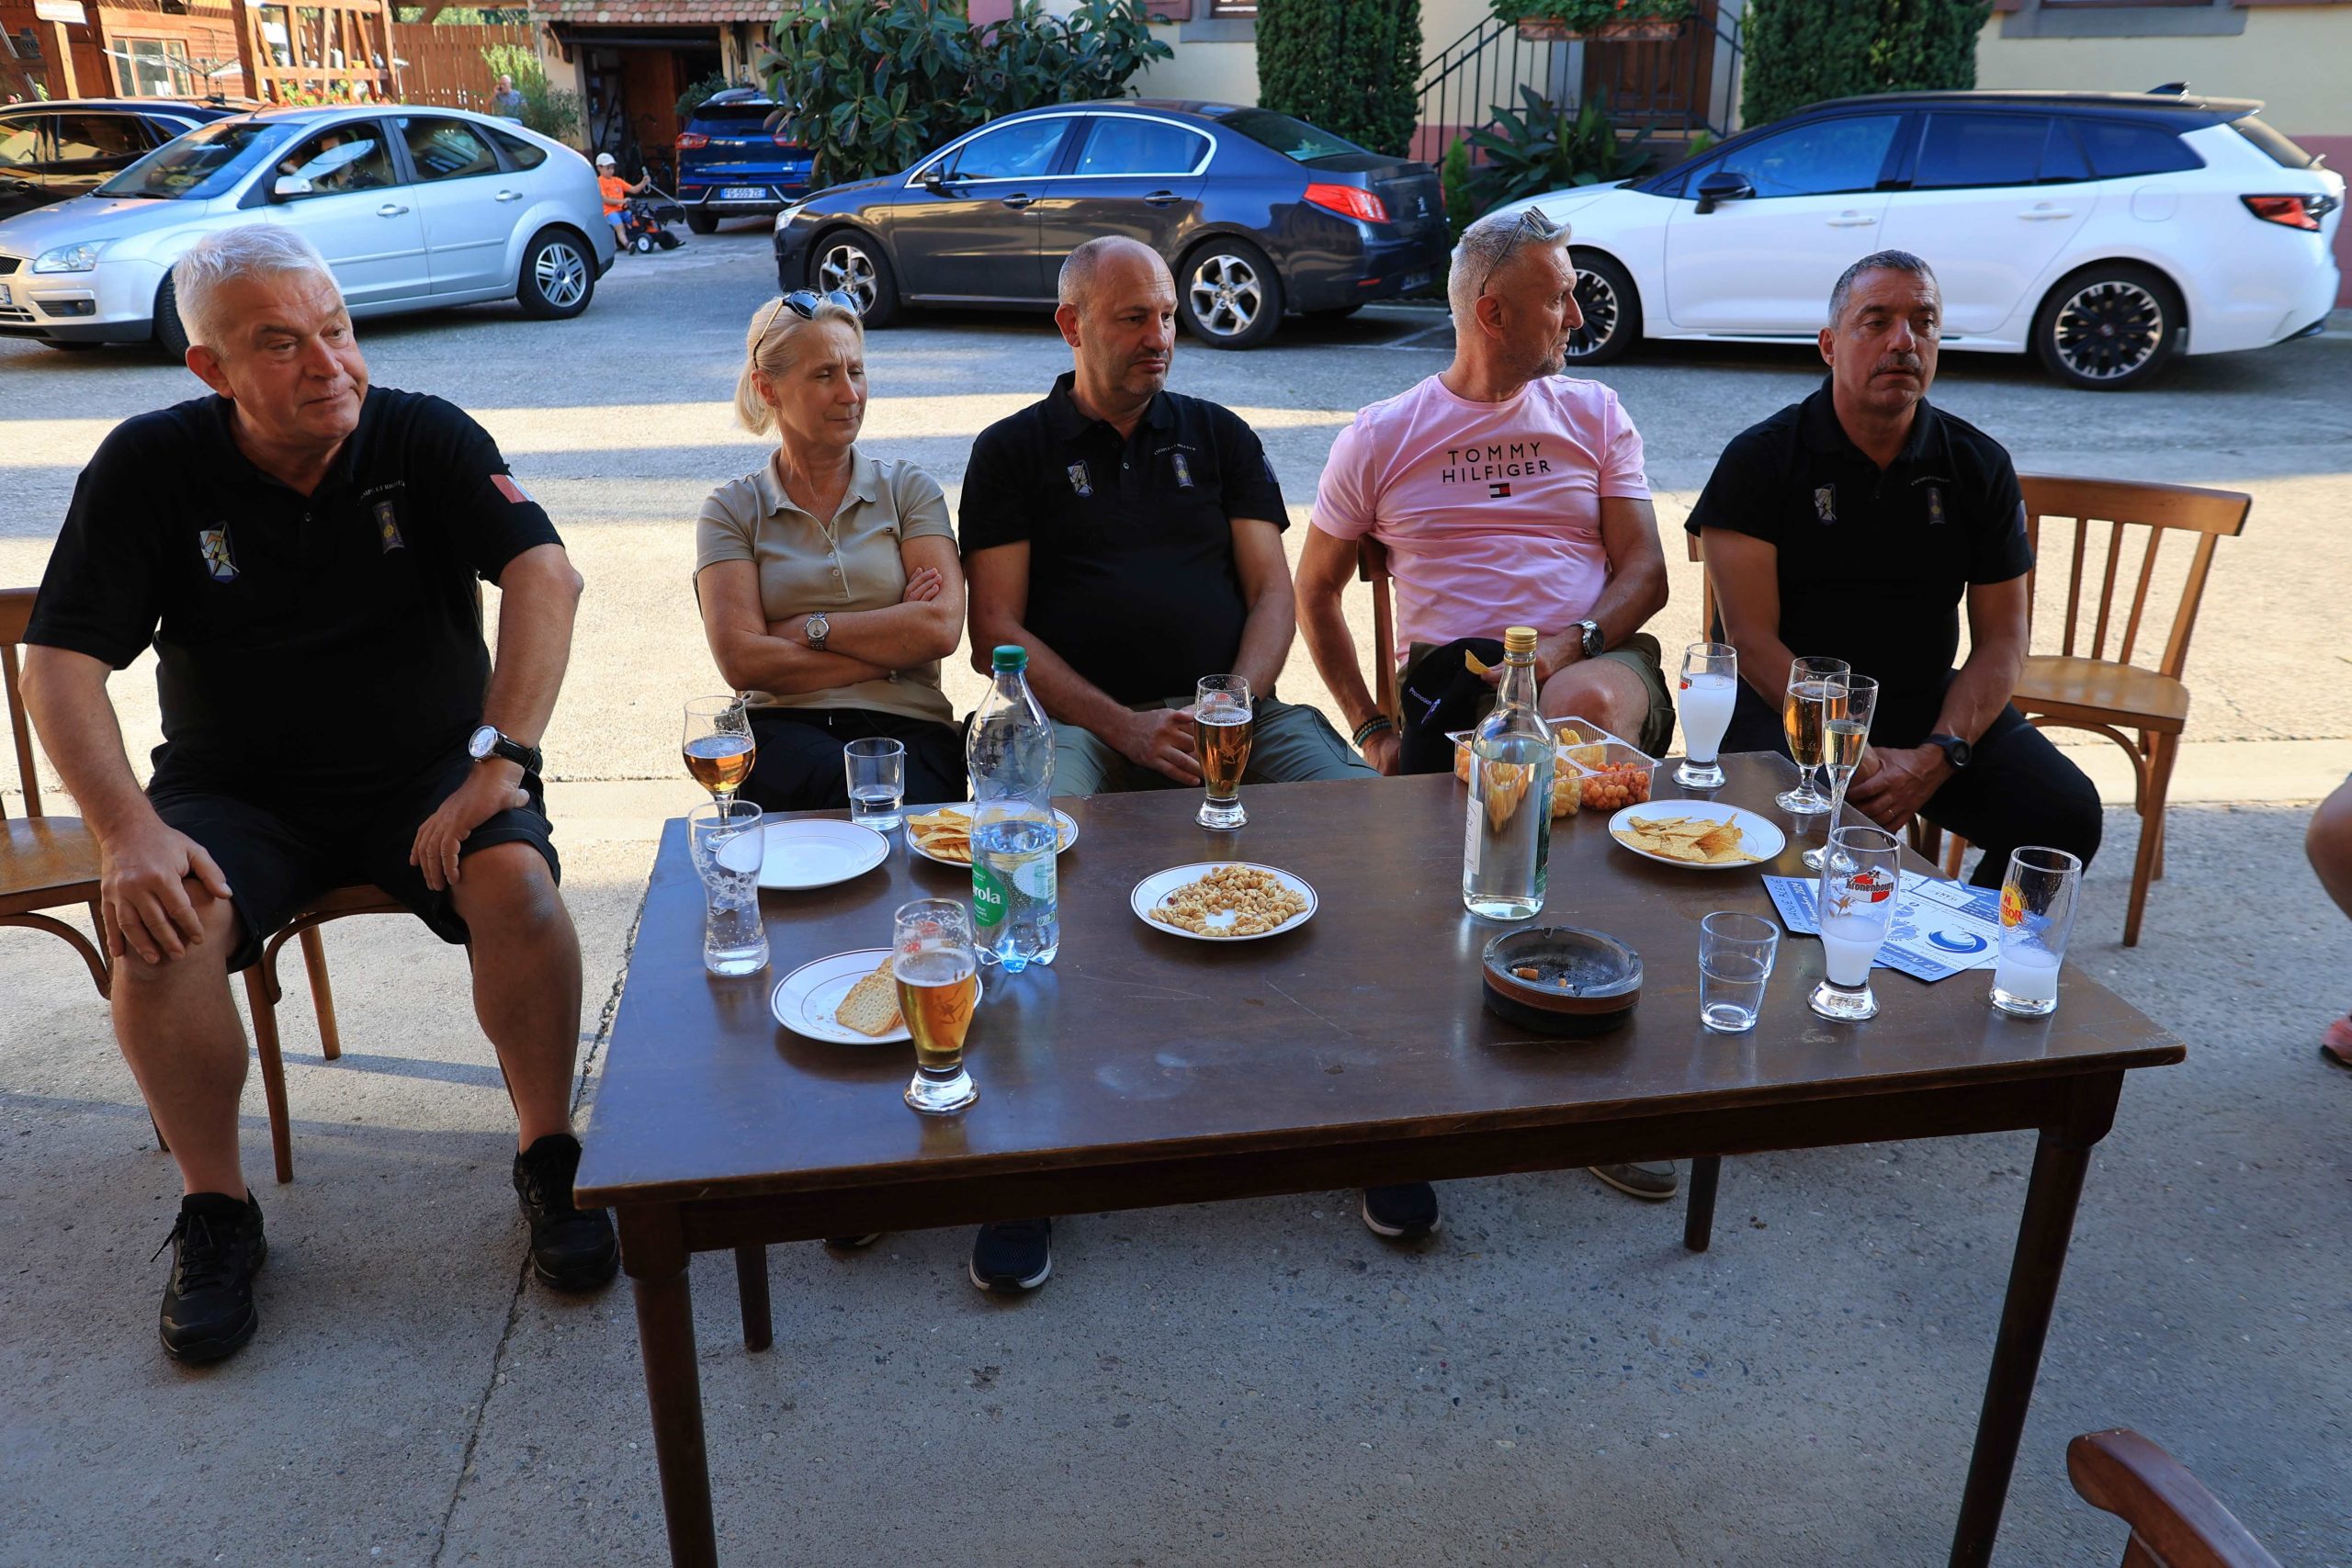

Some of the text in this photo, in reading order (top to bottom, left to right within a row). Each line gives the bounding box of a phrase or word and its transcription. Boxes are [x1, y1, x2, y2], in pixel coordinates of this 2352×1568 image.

[1447, 442, 1541, 466] TOMMY
[1442, 460, 1552, 483] HILFIGER
[2000, 903, 2024, 924] TEOR
